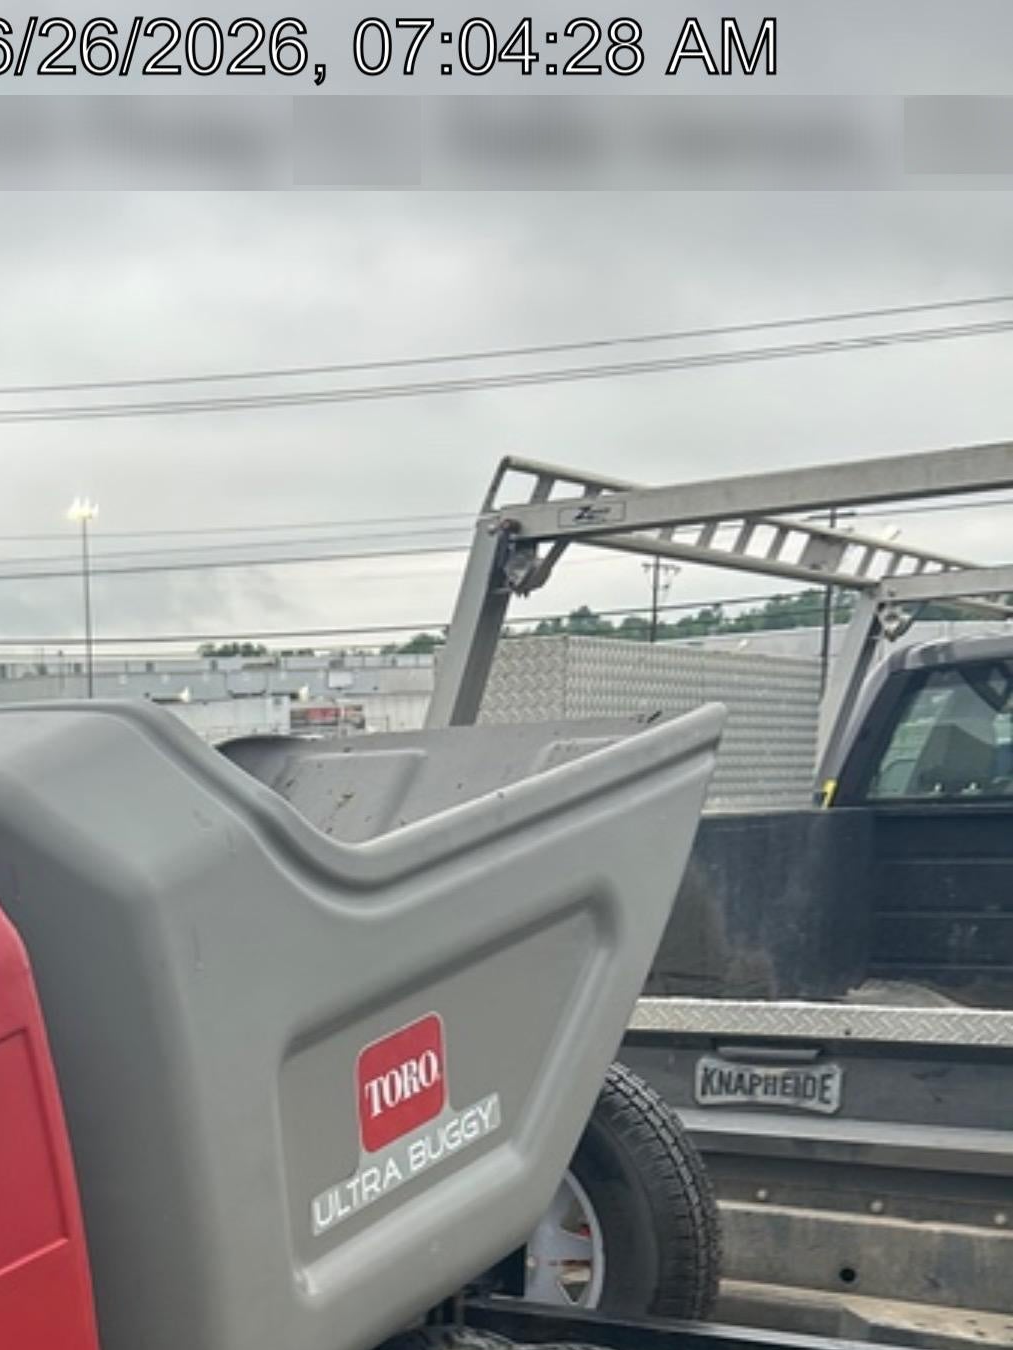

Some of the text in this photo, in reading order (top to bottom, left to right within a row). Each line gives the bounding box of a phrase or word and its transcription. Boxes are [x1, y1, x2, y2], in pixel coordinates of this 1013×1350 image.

[365, 1050, 439, 1119] TORO
[701, 1066, 834, 1104] KNAPHEIDE
[313, 1100, 495, 1227] ULTRA BUGGY
